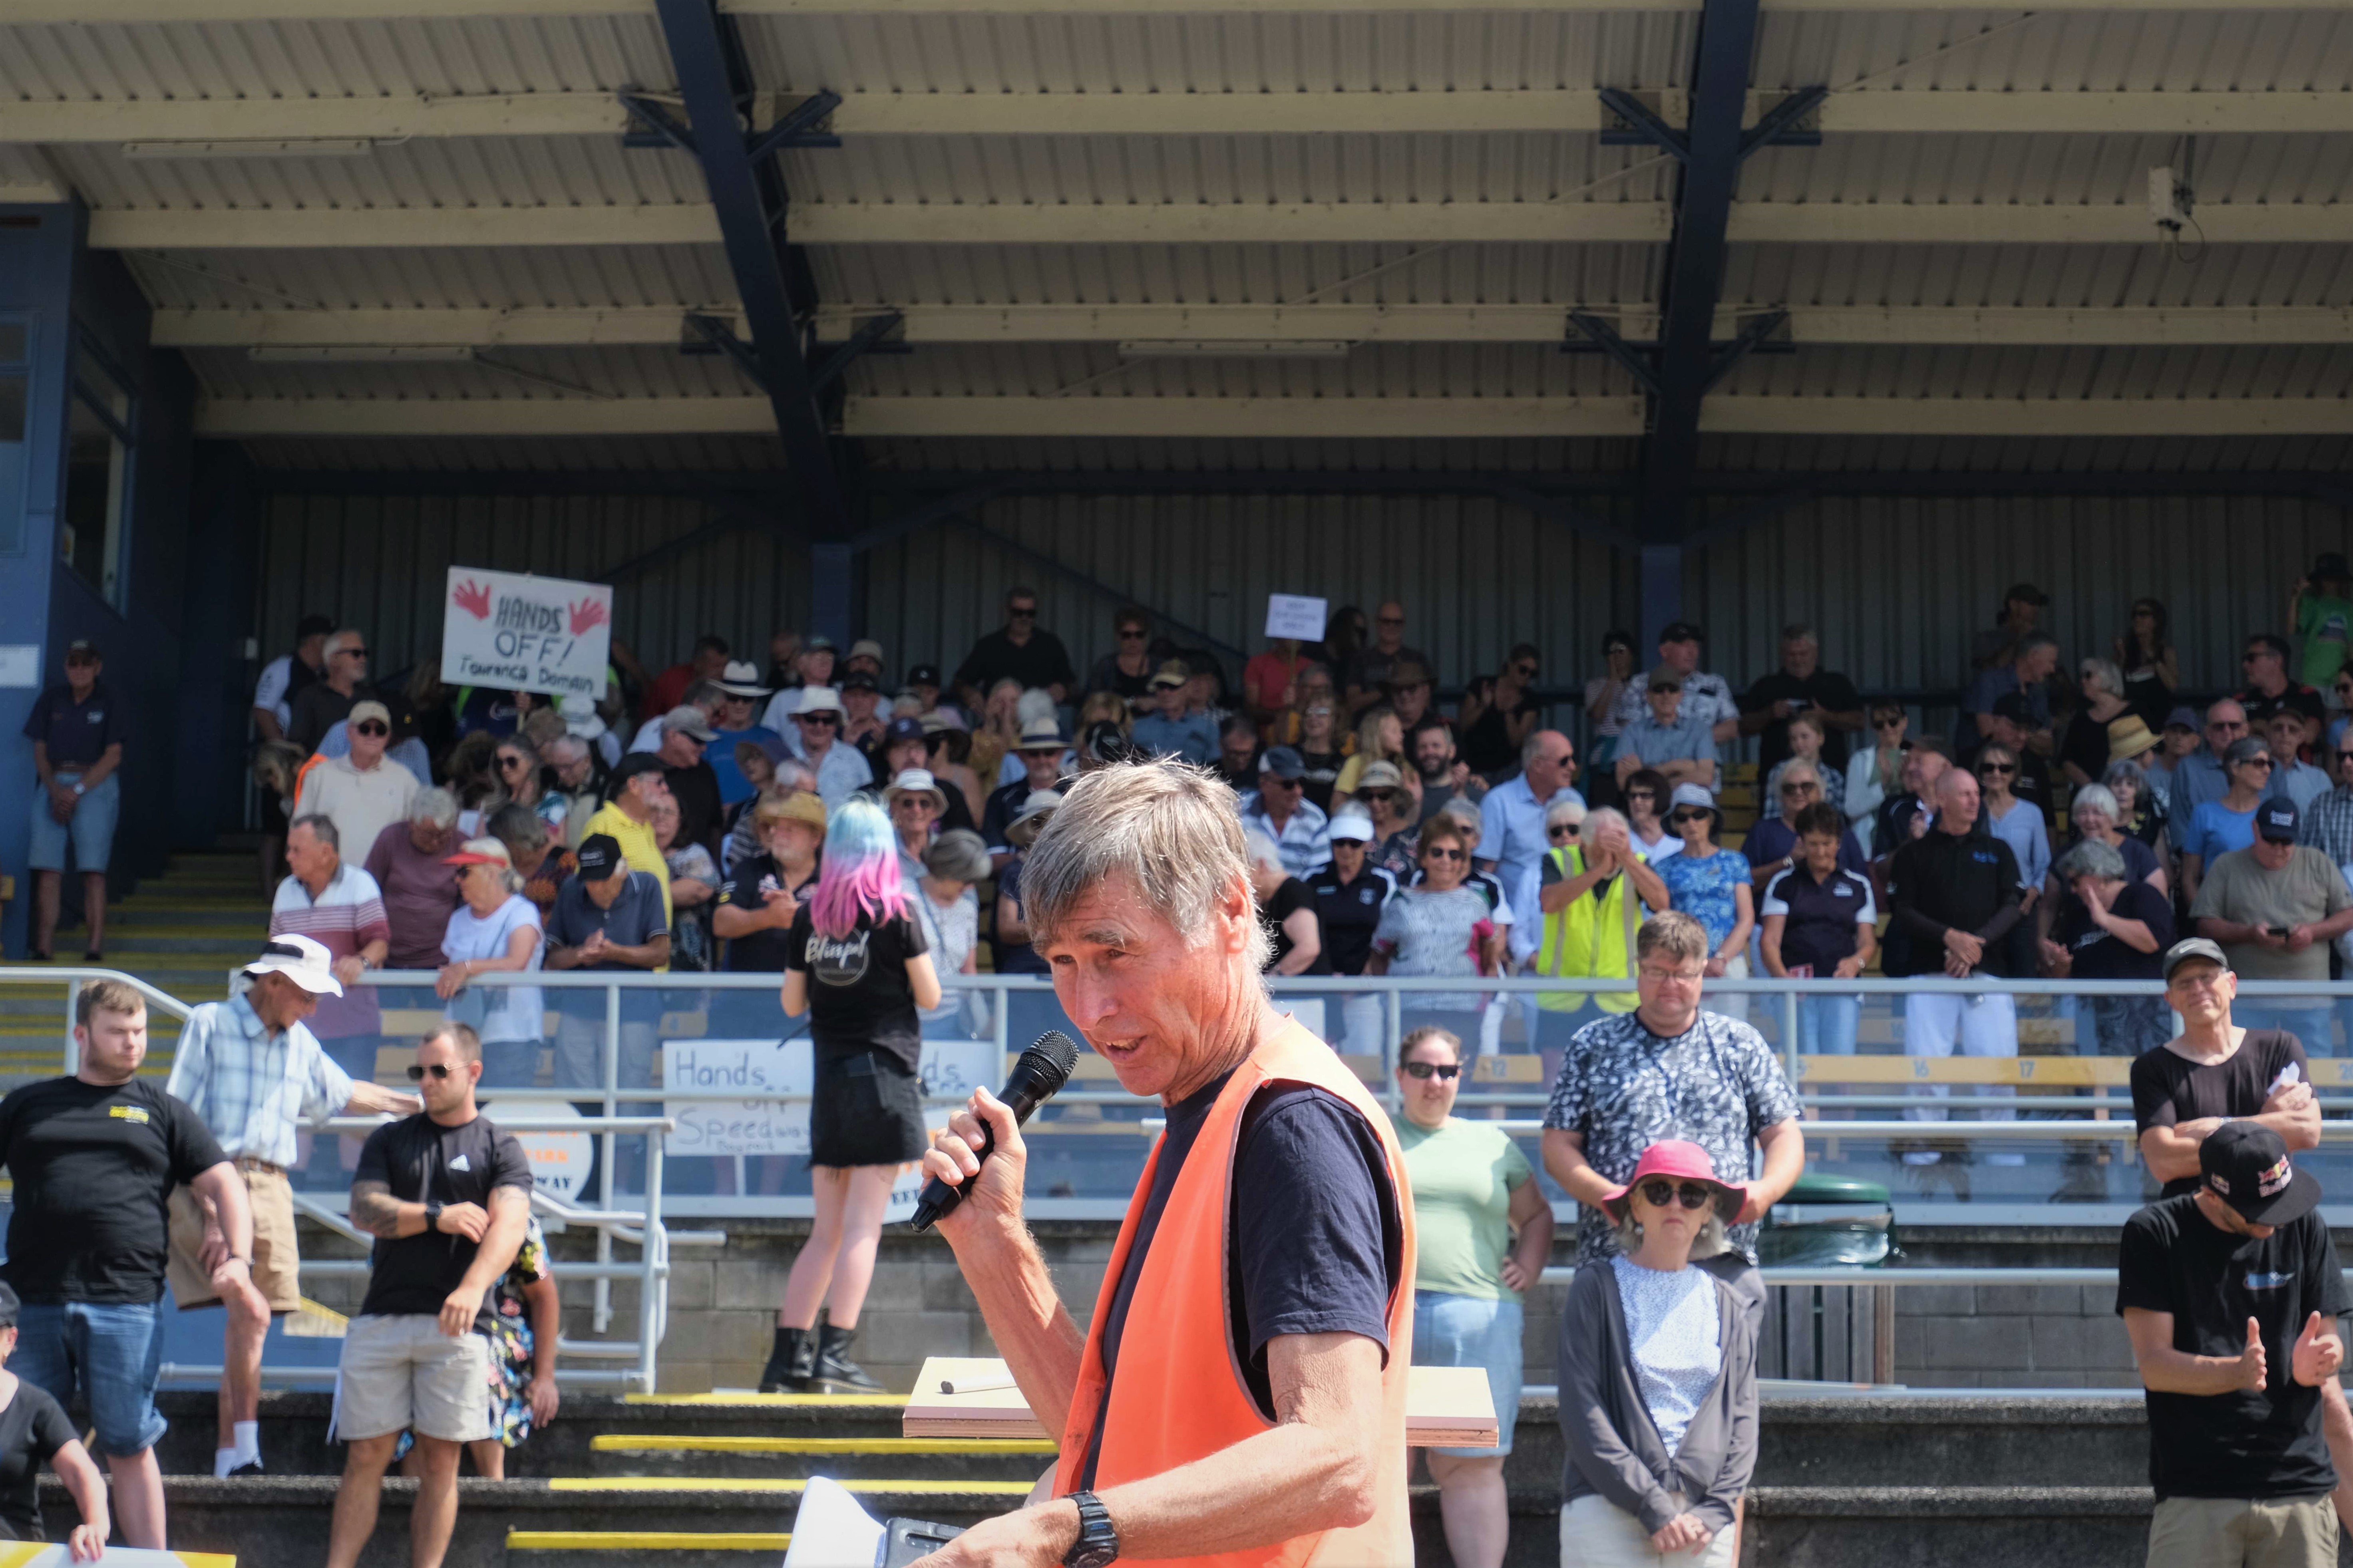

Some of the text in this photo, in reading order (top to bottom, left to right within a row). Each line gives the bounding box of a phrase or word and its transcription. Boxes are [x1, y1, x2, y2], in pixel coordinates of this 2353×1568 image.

[495, 596, 565, 634] HANDS
[495, 630, 574, 667] OFF!
[676, 1048, 766, 1086] Hands
[1913, 1060, 1929, 1078] 16
[2019, 1060, 2035, 1078] 17
